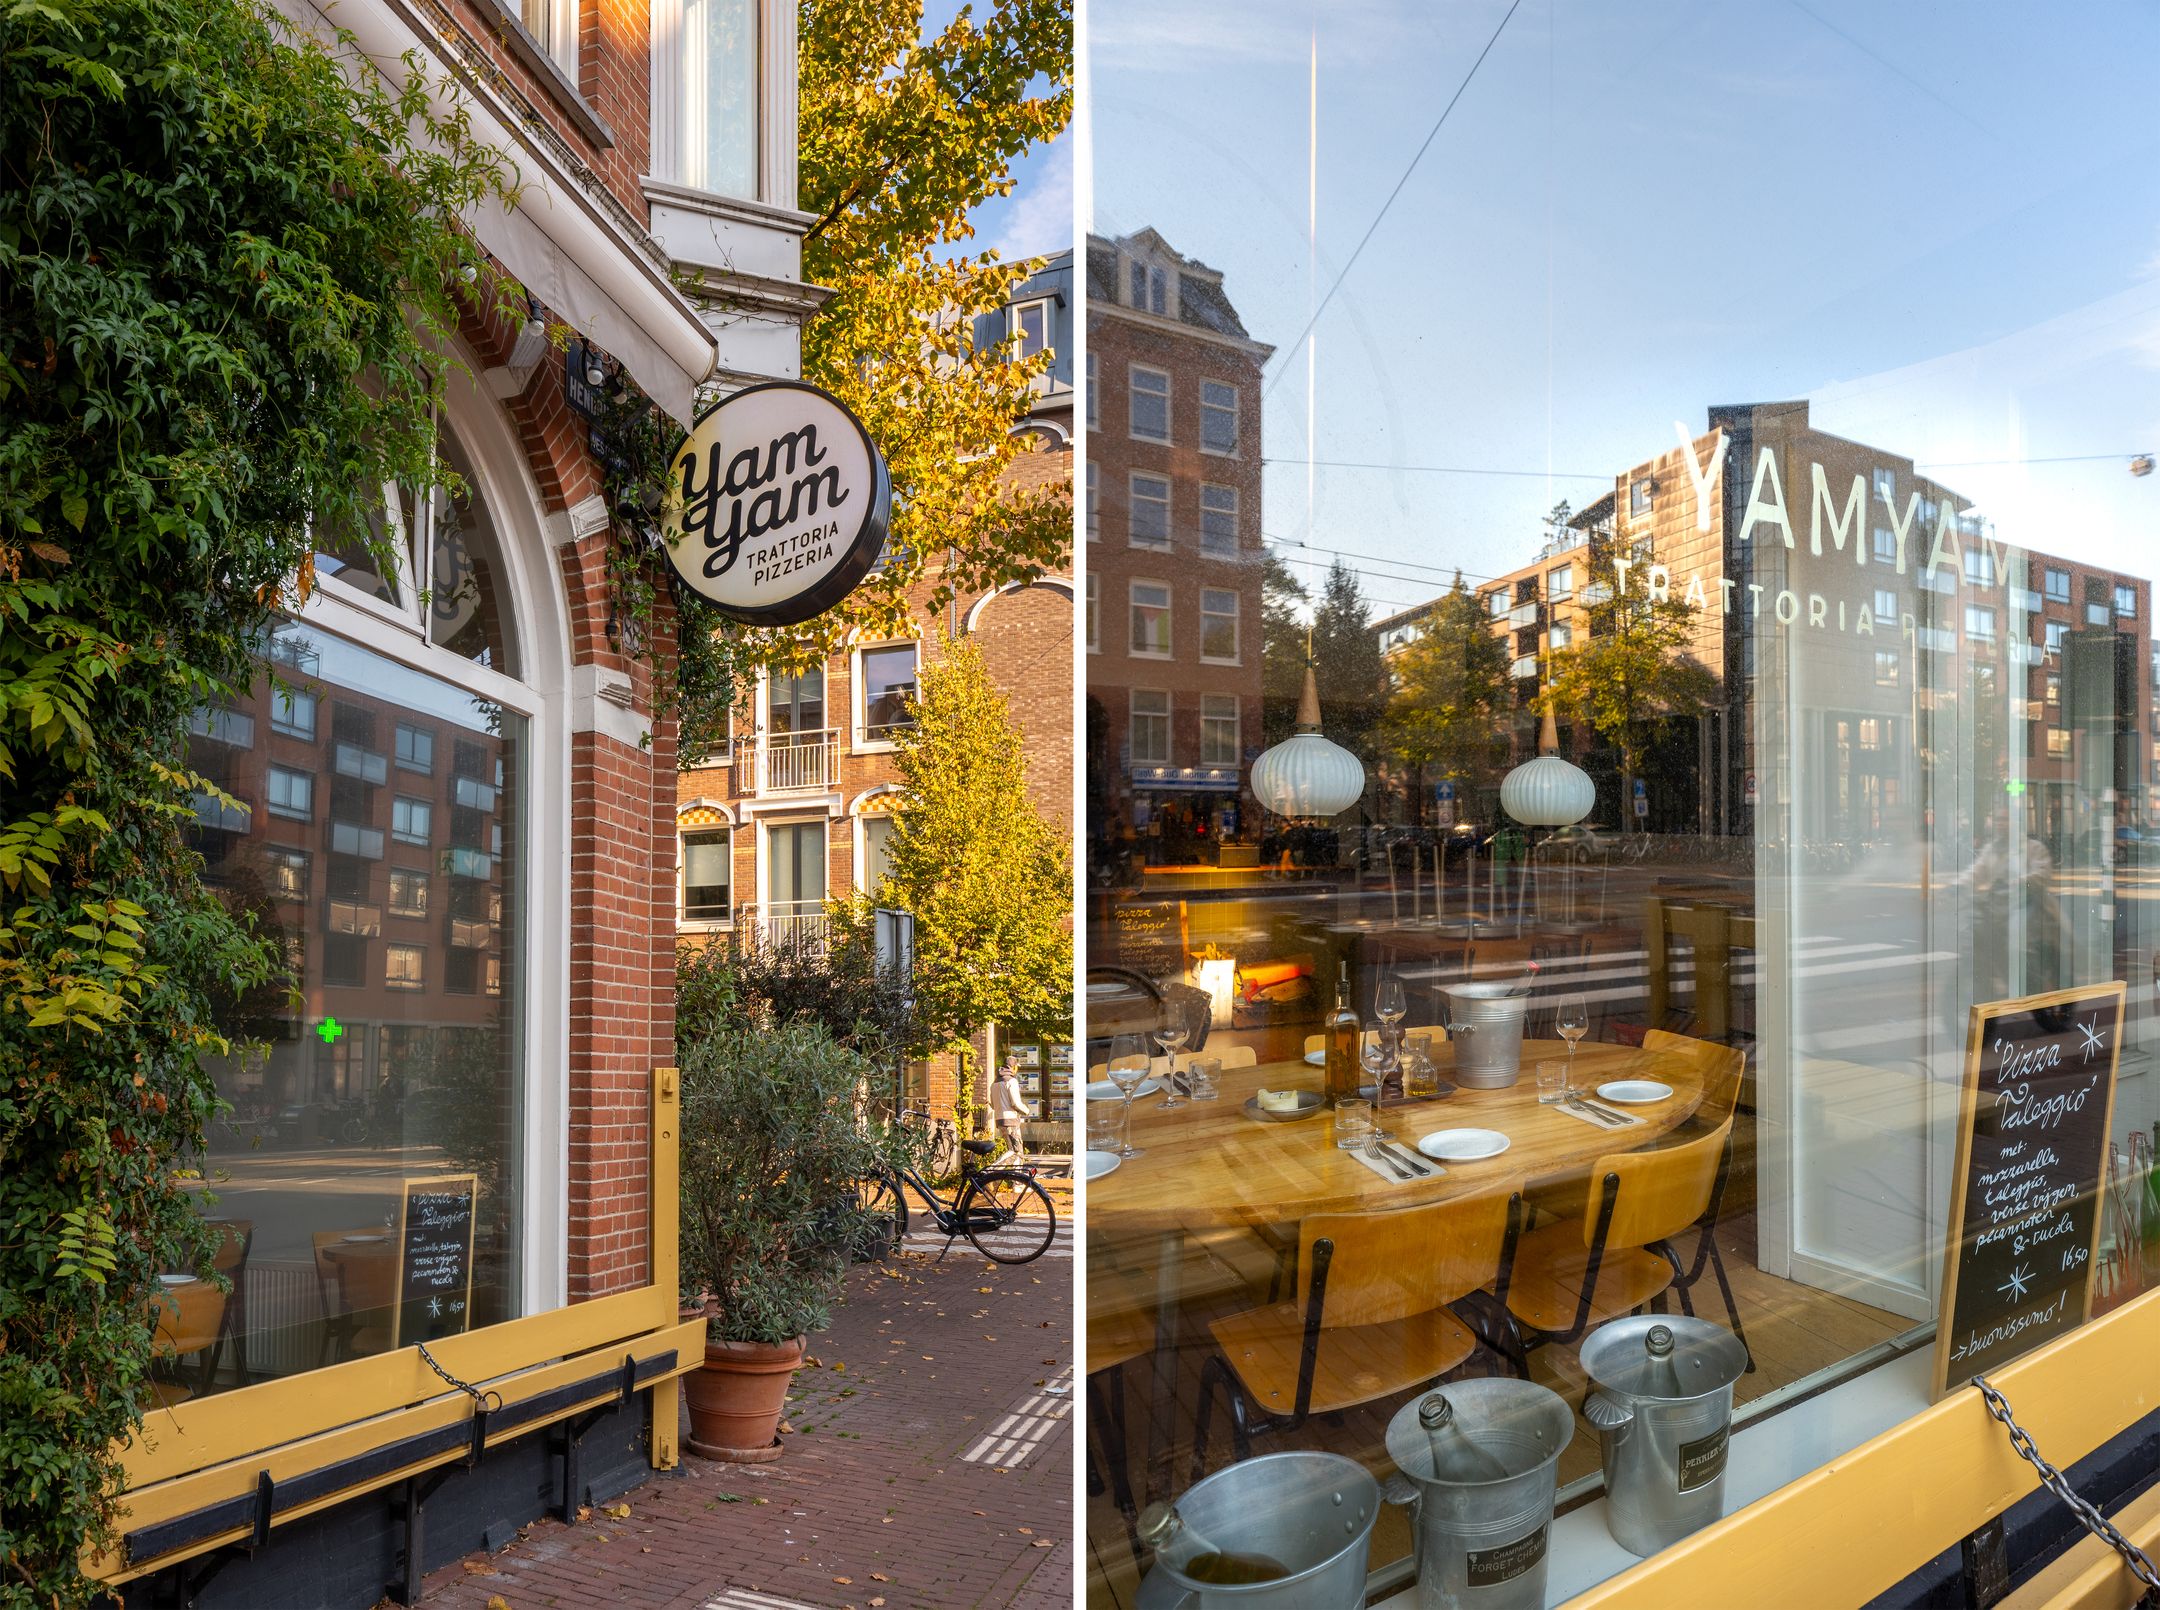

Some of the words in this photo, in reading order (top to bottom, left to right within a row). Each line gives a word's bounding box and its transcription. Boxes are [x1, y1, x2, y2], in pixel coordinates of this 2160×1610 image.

[1674, 420, 2022, 593] YAMYAM
[746, 520, 839, 570] TRATTORIA
[754, 542, 834, 587] PIZZERIA
[1613, 557, 1876, 637] TRATTORIA
[1977, 1147, 2059, 1187] mozzarella,
[2000, 1140, 2027, 1159] met:
[1984, 1174, 2047, 1206] taleggio,
[1990, 1200, 2029, 1224] verse
[2032, 1183, 2080, 1210] vijgen,
[2013, 1234, 2030, 1256] &
[2033, 1212, 2075, 1245] rucola
[2061, 1244, 2088, 1271] 16,50
[1471, 1557, 1514, 1573] FORGET
